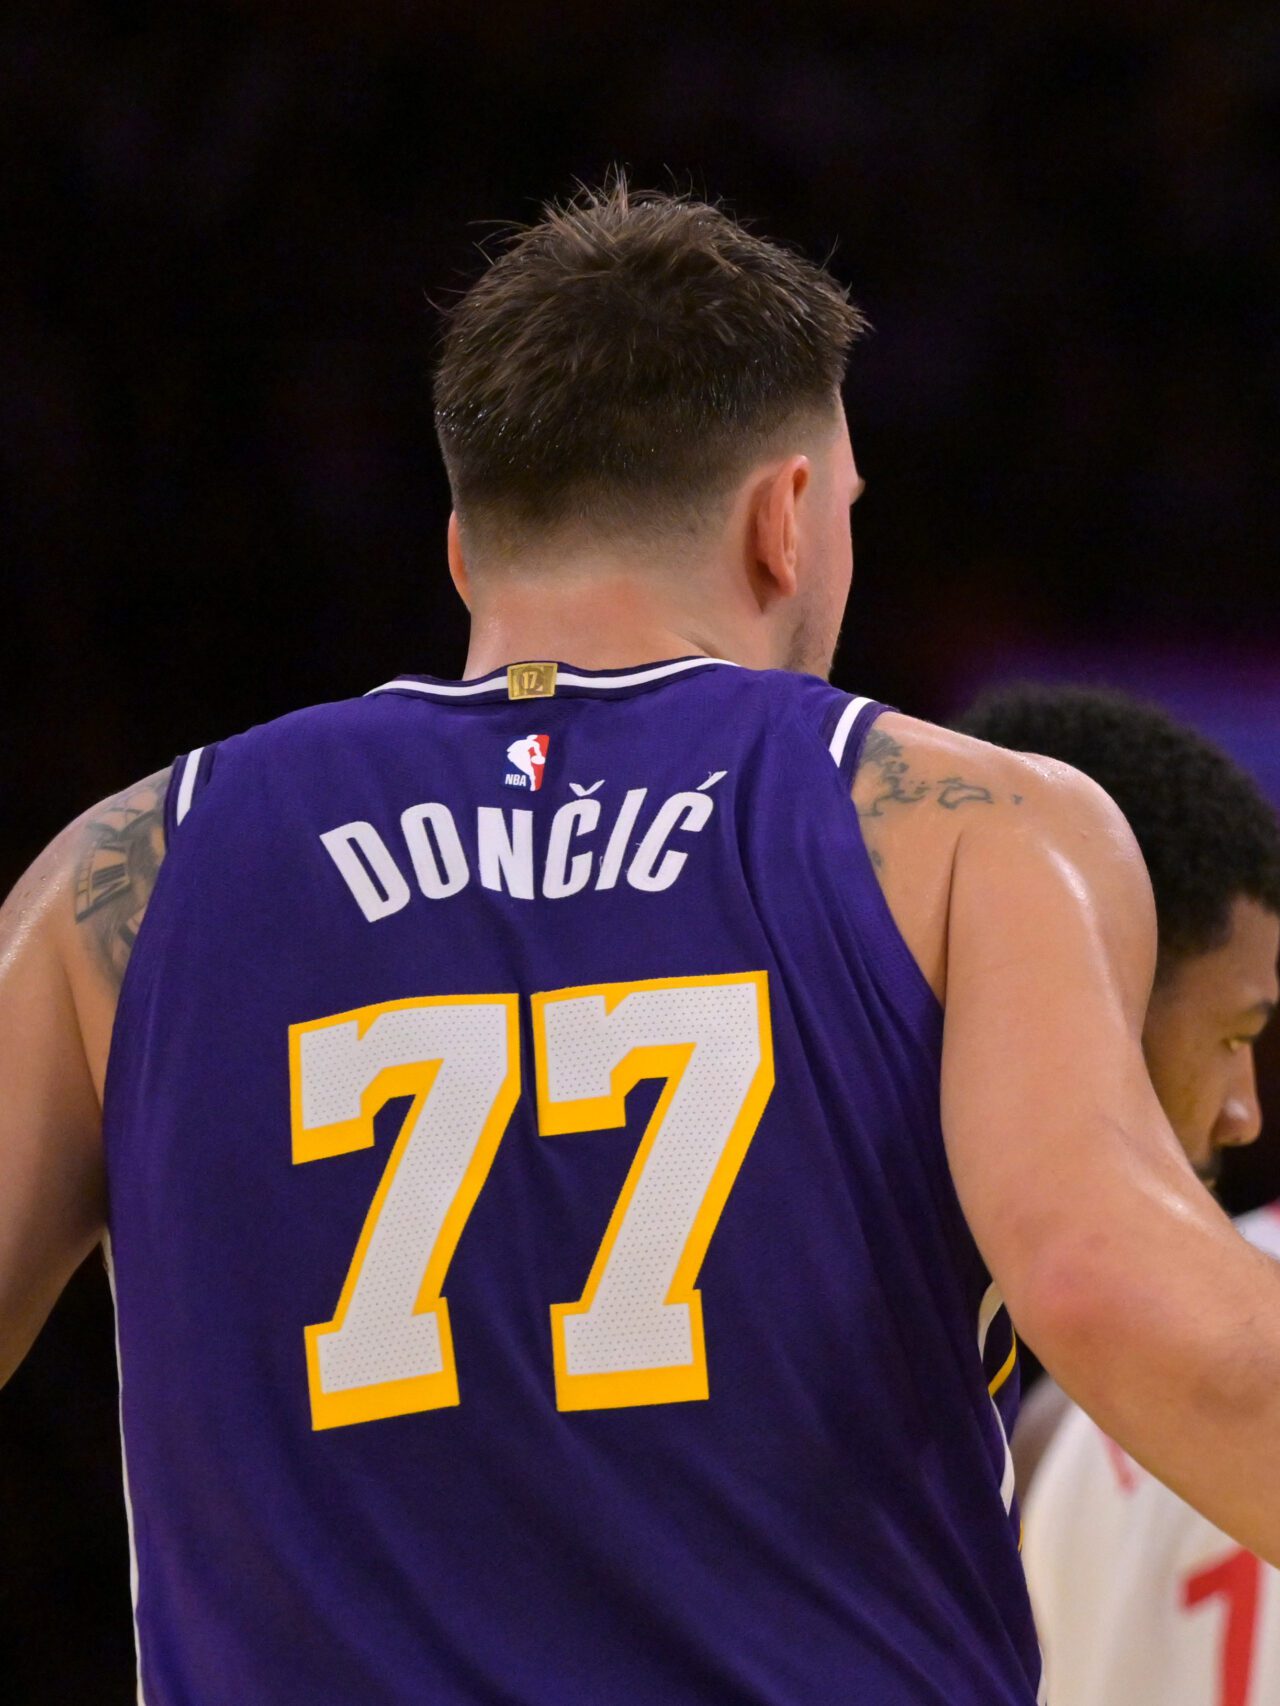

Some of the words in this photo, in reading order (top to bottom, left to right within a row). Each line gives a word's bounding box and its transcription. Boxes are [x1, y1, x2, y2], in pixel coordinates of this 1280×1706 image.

[522, 671, 538, 690] 17
[505, 773, 527, 787] NBA
[319, 769, 728, 923] DONČIĆ
[288, 969, 776, 1431] 77
